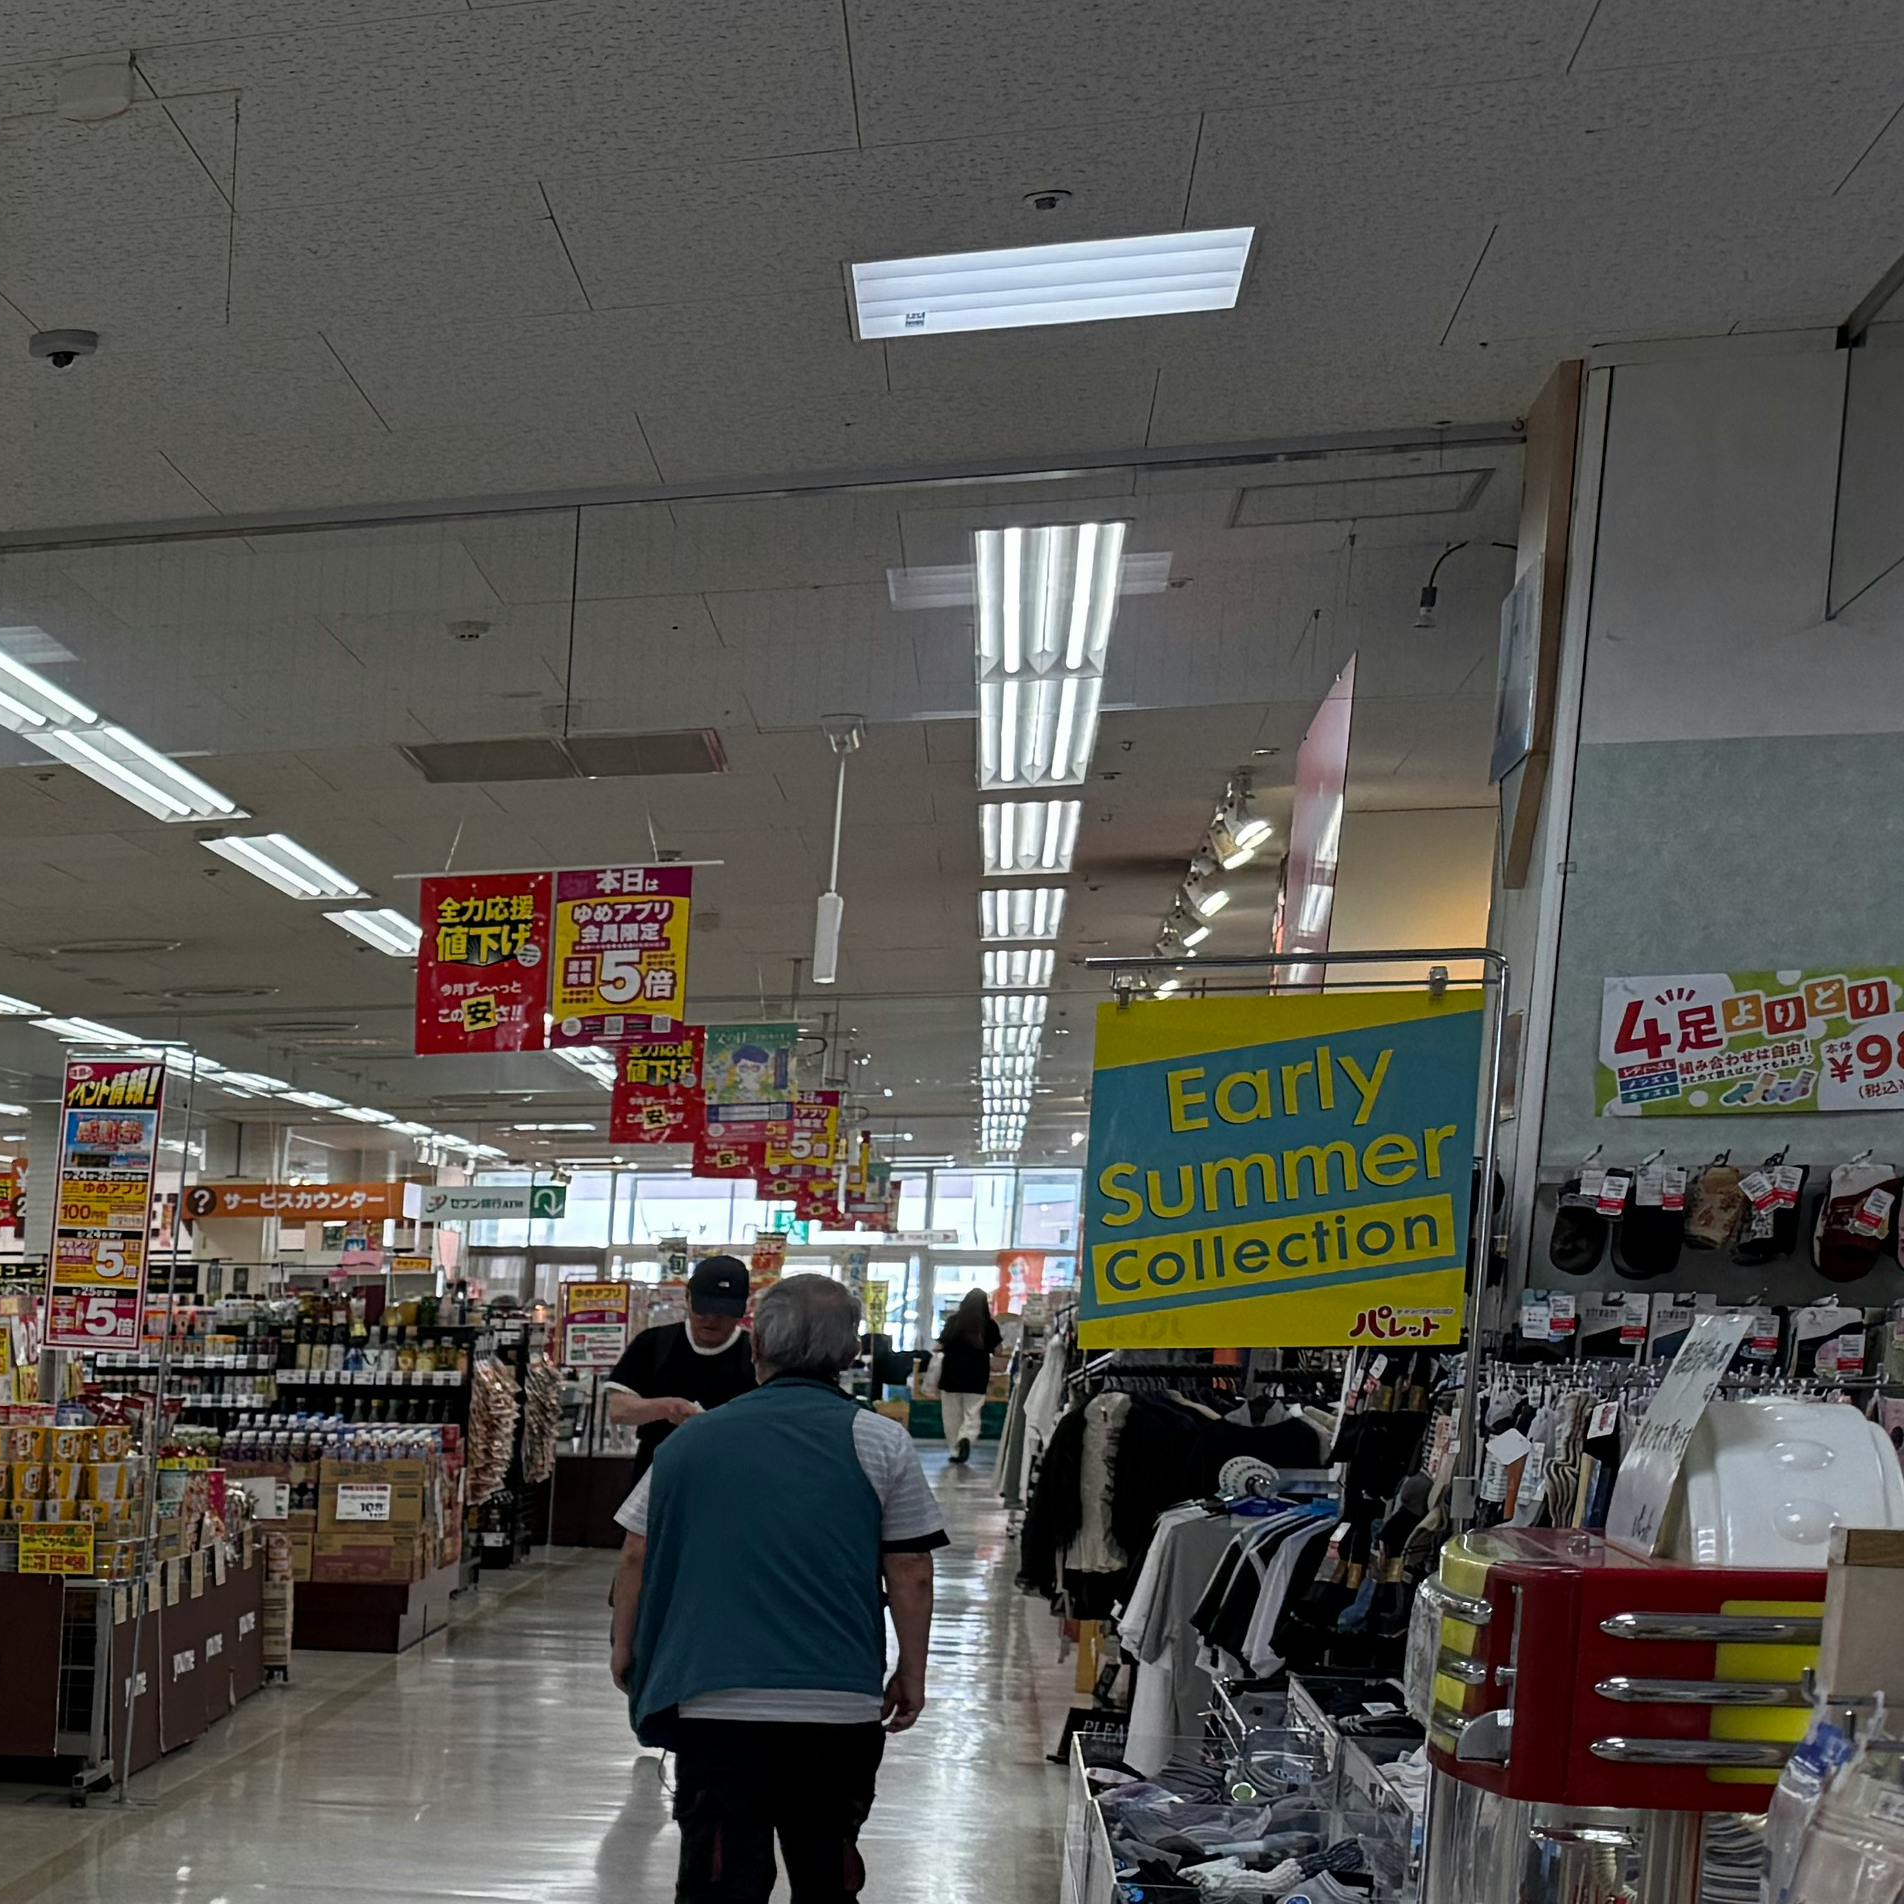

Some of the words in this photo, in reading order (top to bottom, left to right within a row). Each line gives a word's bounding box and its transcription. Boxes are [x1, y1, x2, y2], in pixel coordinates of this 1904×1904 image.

[596, 869, 660, 893] 本日は
[437, 895, 535, 923] 全力応援
[573, 902, 671, 922] ゆめアプリ
[436, 923, 533, 963] 値下げ
[581, 923, 660, 943] 会員限定
[598, 949, 676, 1003] 5倍
[1614, 981, 1882, 1060] 4足よりどり
[1679, 1041, 1810, 1075] 組み合わせは自由!
[67, 1066, 162, 1107] イベント情報!
[1166, 1045, 1395, 1134] Early
[83, 1183, 146, 1196] ゆめアプリ
[1098, 1124, 1457, 1227] Summer
[223, 1190, 385, 1211] サービスカウンター
[1104, 1212, 1439, 1293] Collection
[1349, 1306, 1441, 1339] パレット
